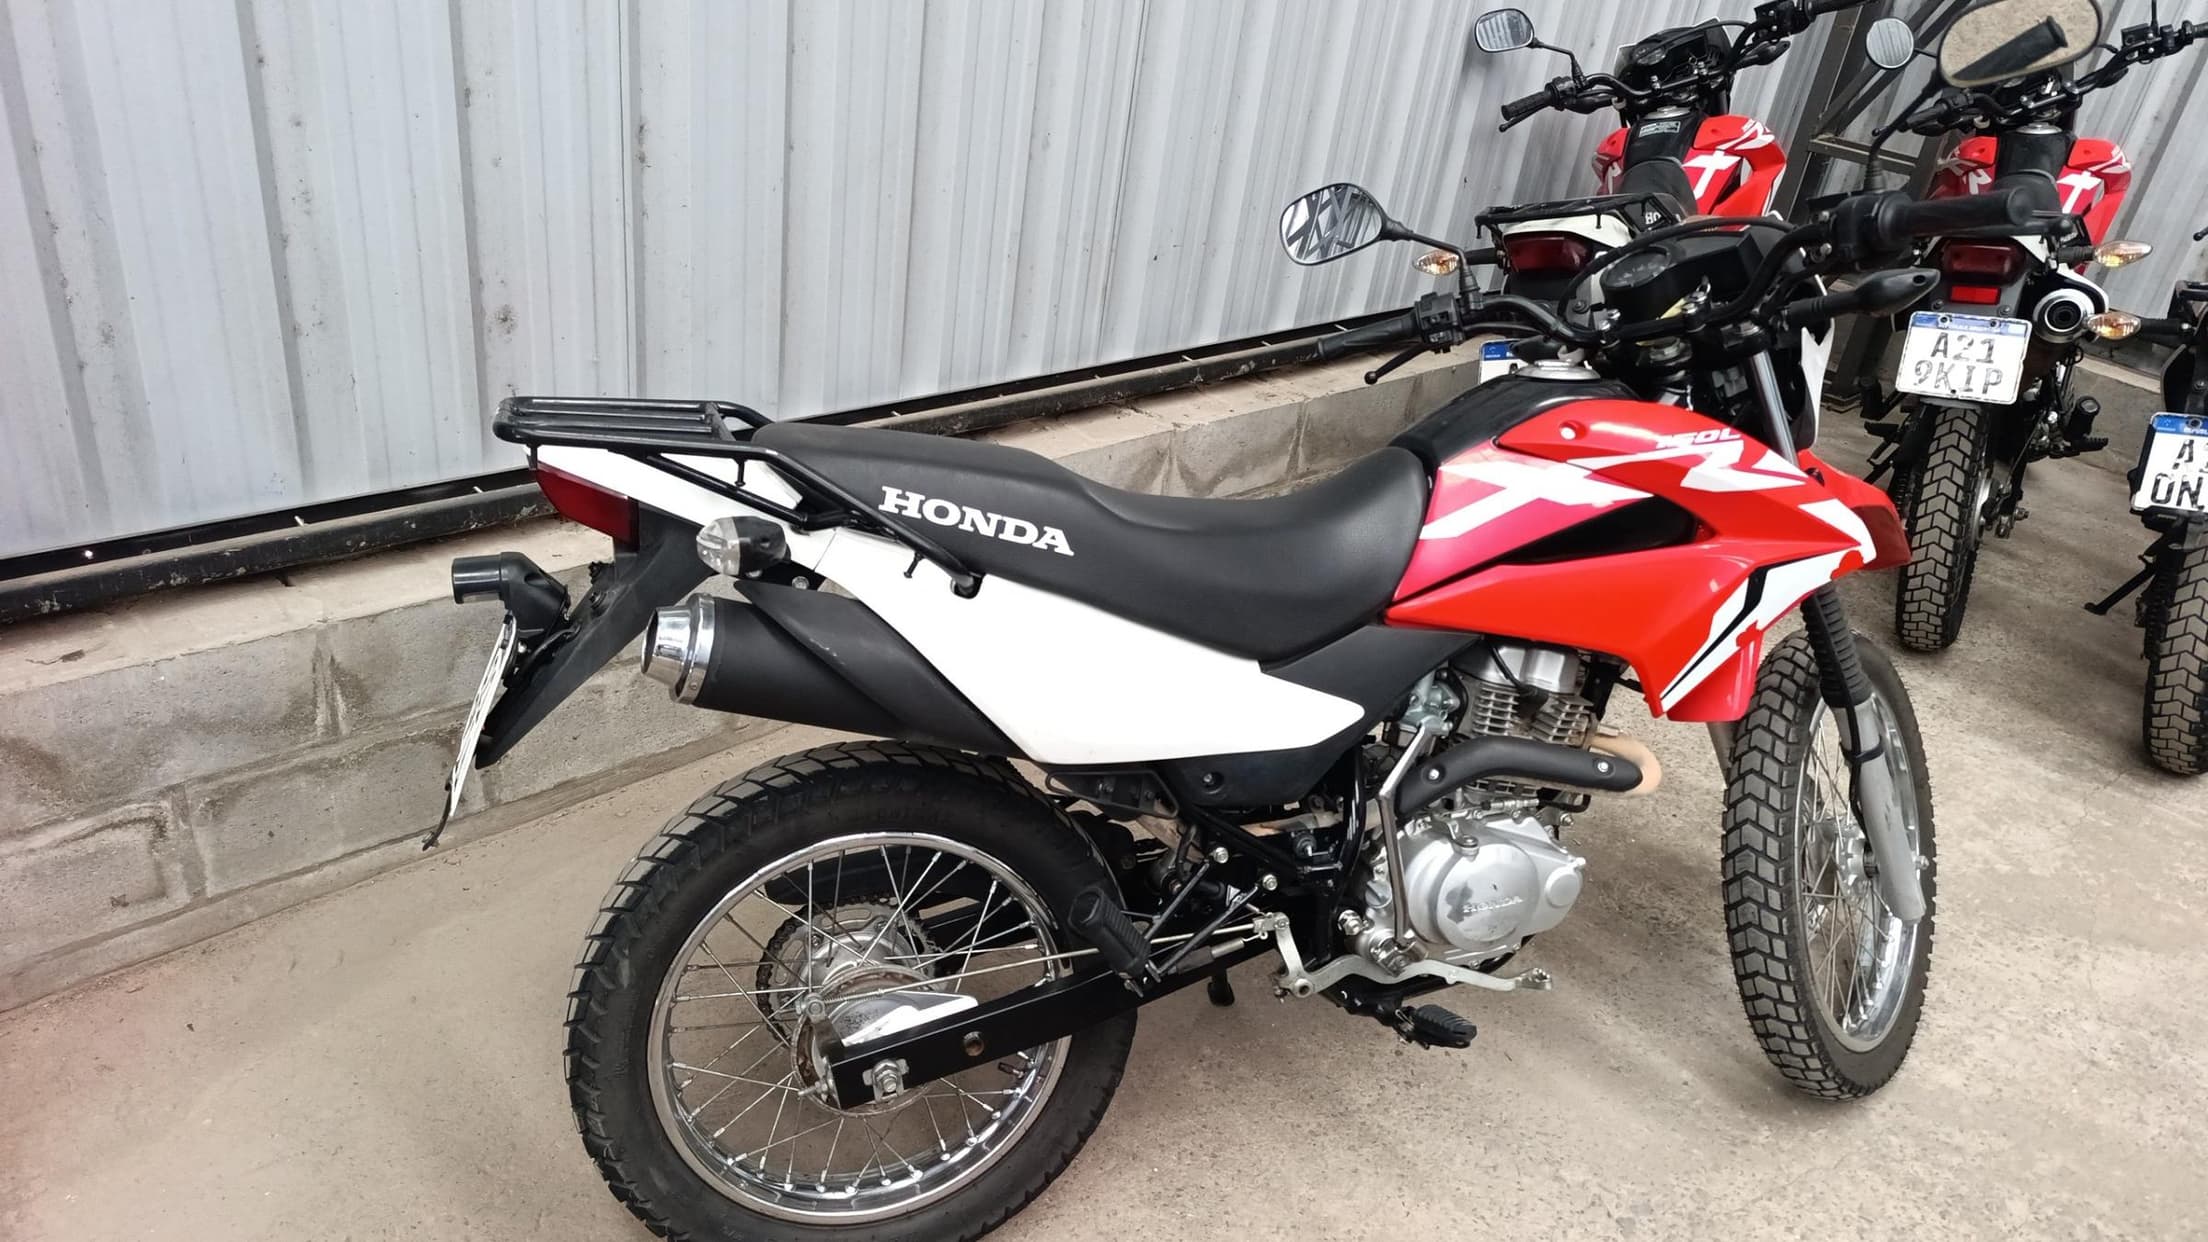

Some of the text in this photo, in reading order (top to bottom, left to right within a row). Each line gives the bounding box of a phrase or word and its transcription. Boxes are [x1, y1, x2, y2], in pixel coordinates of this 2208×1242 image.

[1930, 331, 1996, 364] A21
[1913, 359, 2005, 395] 9KIP
[878, 485, 1075, 557] HONDA
